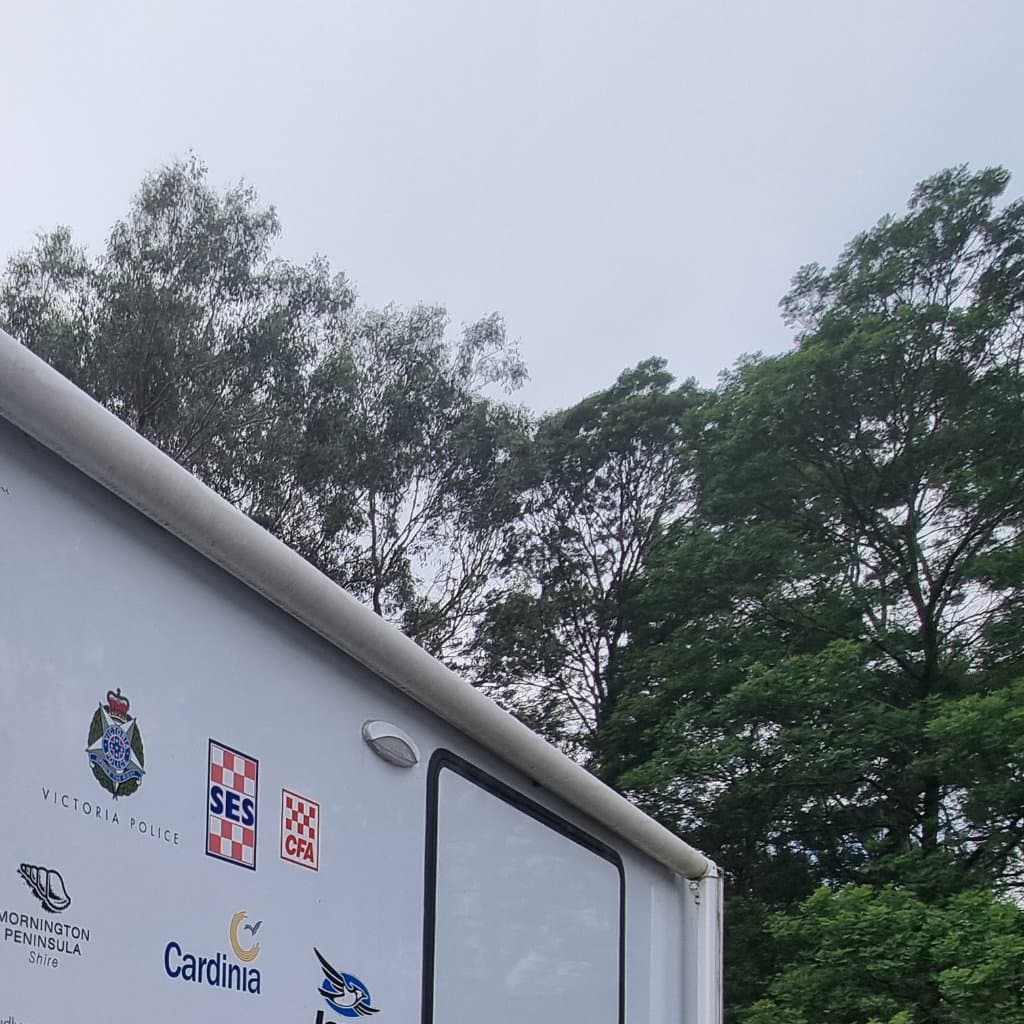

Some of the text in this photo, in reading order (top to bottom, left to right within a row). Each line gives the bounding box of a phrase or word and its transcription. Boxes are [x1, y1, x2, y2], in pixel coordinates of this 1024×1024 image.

[42, 787, 179, 845] VICTORIA POLICE
[210, 785, 255, 826] SES
[285, 834, 315, 863] CFA
[4, 928, 82, 956] PENINSULA
[28, 950, 59, 968] Shire
[164, 941, 261, 995] Cardinia
